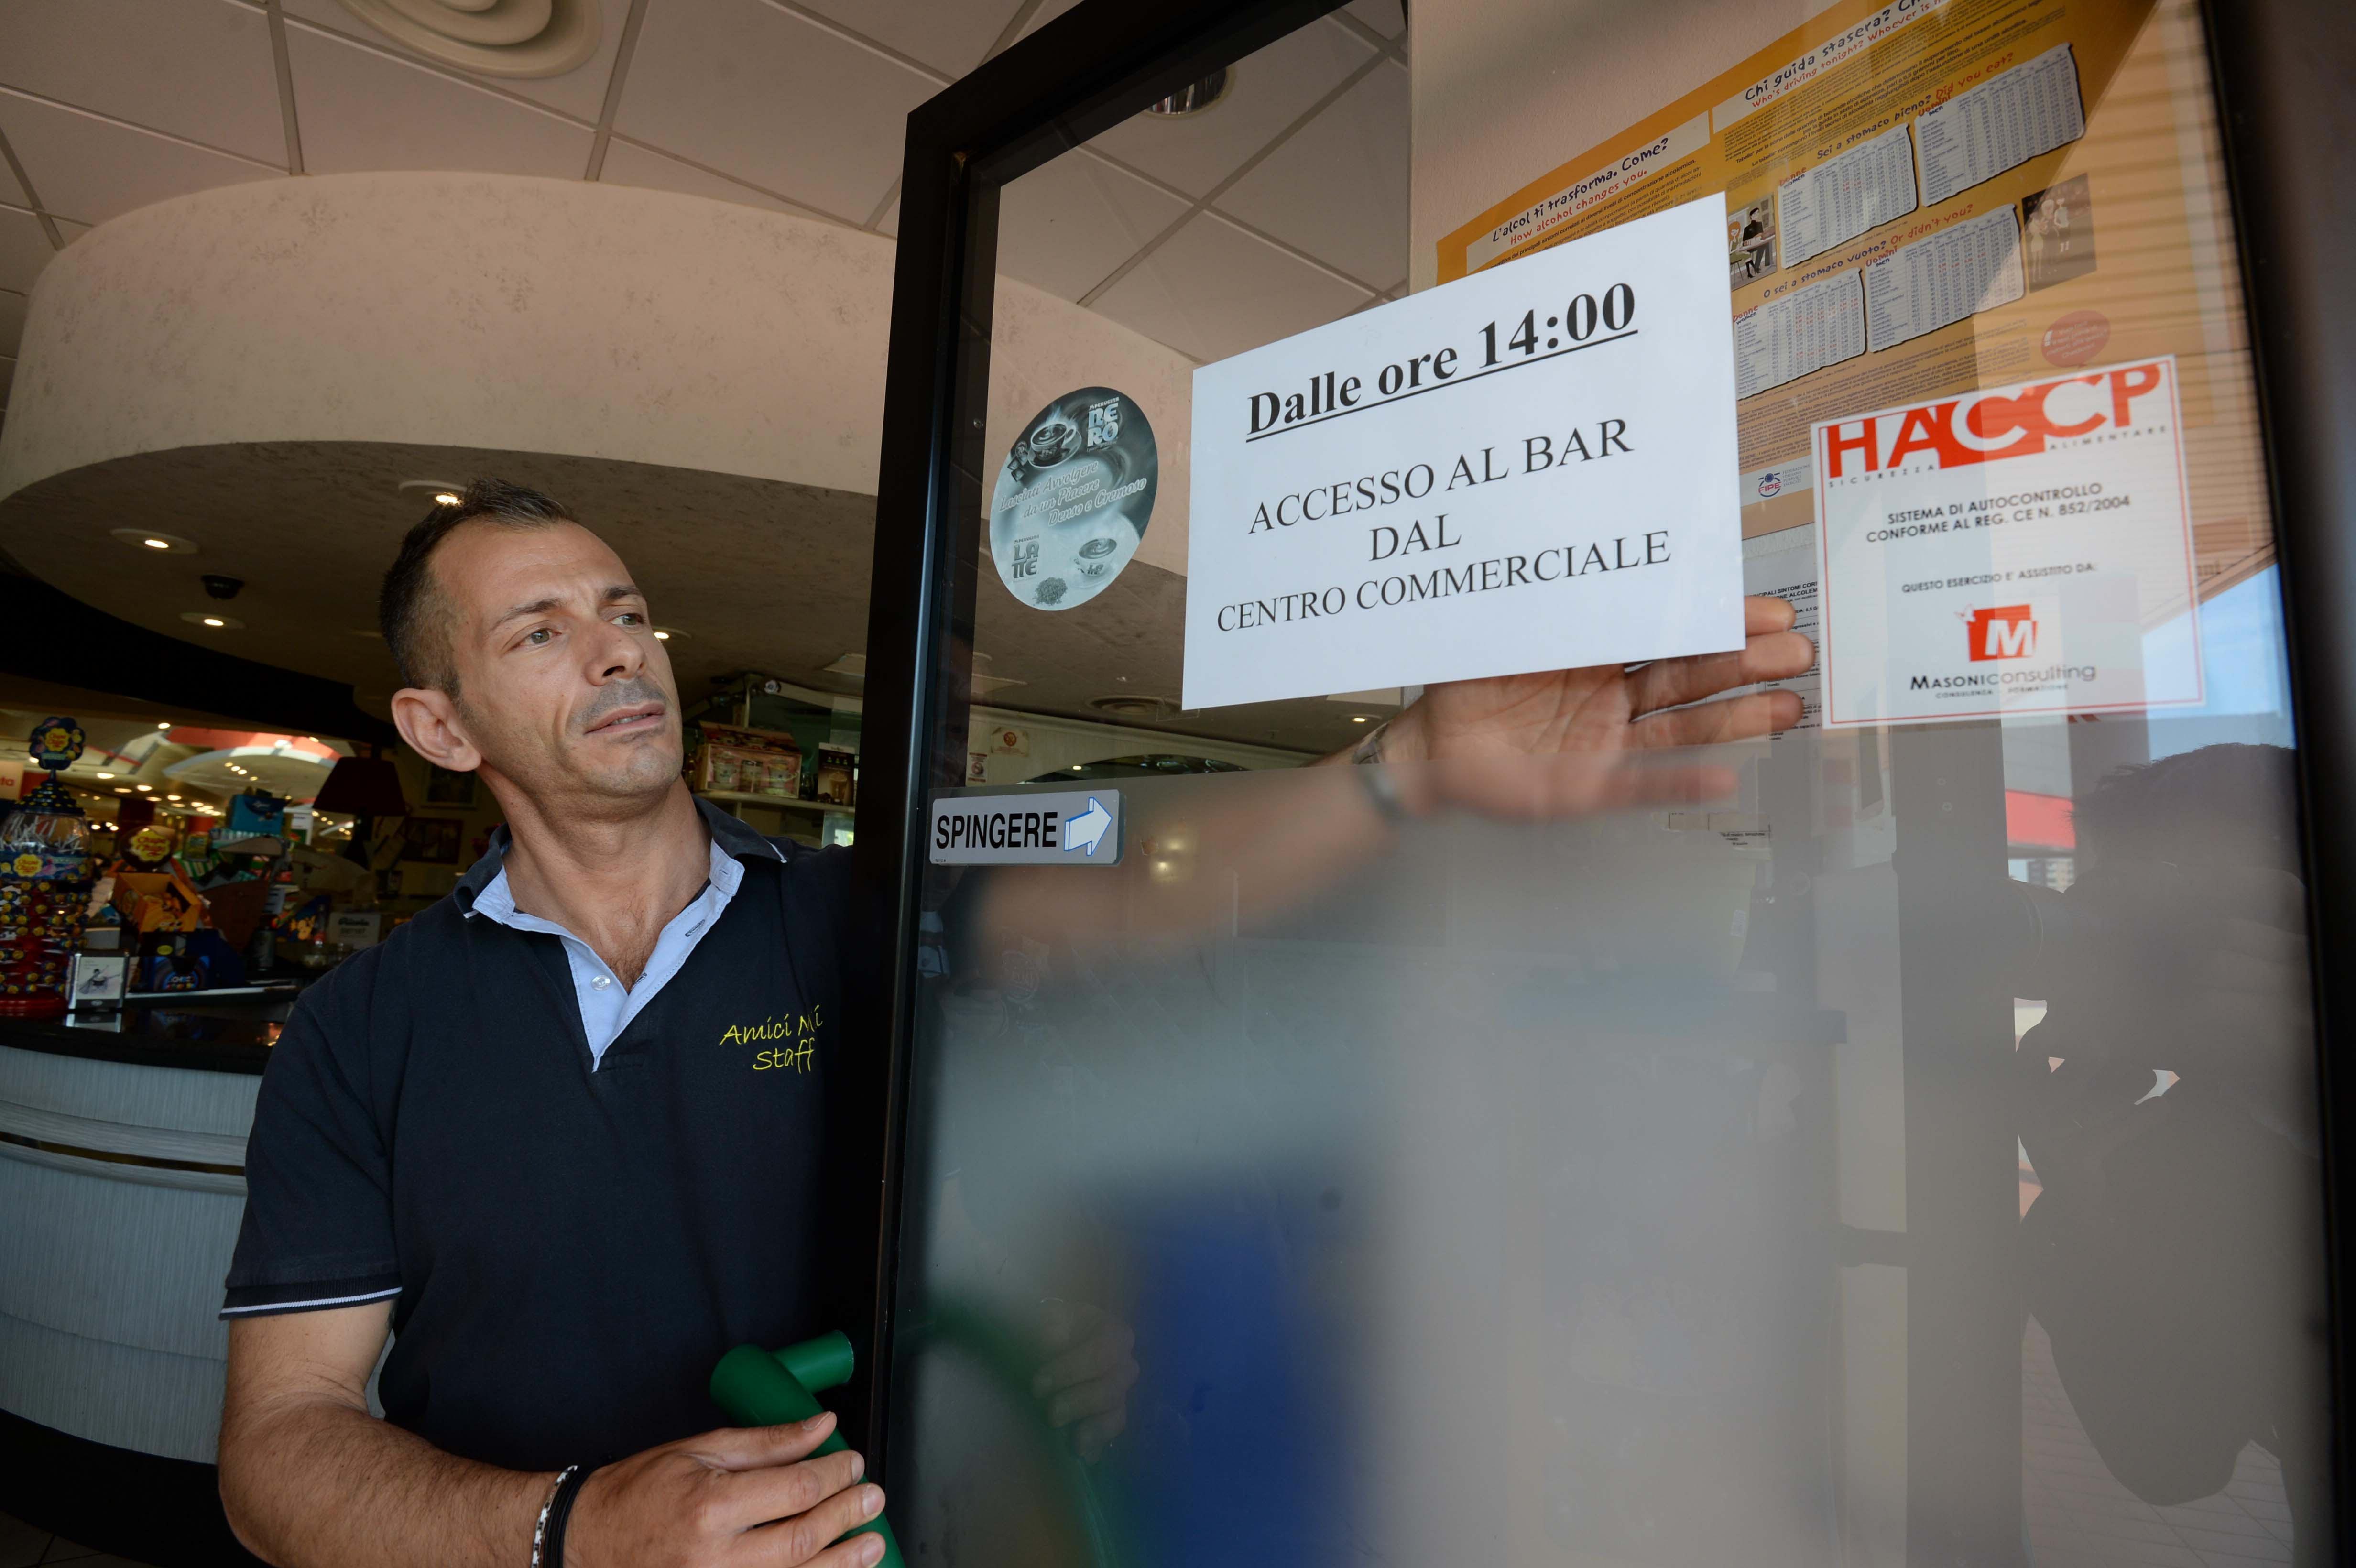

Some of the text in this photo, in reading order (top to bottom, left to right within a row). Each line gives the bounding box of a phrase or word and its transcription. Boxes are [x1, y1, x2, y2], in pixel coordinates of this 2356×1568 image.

[1745, 9, 1890, 100] Chi guida stasera?
[1752, 88, 1781, 109] Who's
[1784, 68, 1817, 90] driving
[1821, 40, 1864, 68] tonight?
[1867, 10, 1917, 43] Whoever
[1921, 4, 1930, 13] is
[1914, 59, 1934, 75] grammi
[1936, 54, 1945, 63] per
[1778, 135, 1807, 153] contengono
[1910, 72, 1924, 83] dopo
[1817, 52, 2014, 159] Sei a stomaco pieno? Did you eat?
[1823, 102, 1845, 117] bevande
[1847, 89, 1870, 105] alcoliche
[1883, 63, 1917, 85] determinano
[1918, 94, 1951, 117] Uomini
[1929, 106, 1943, 116] men
[1493, 138, 1669, 242] L'alcol ti trasforma. Come?
[1779, 166, 1807, 186] Donne
[1510, 170, 1647, 245] How alcohol changes you.
[1519, 240, 1540, 256] principali
[1542, 230, 1559, 243] sintomi
[1560, 219, 1580, 234] correlati
[1624, 175, 1664, 200] concentrazione
[1665, 159, 1696, 178] alcolemica.
[1763, 289, 1771, 298] O
[1774, 283, 1788, 295] sei
[1801, 261, 1843, 283] stomaco
[1847, 240, 1887, 263] vuoto?
[1890, 234, 1904, 245] Or
[1908, 218, 1940, 238] didn't
[1943, 204, 1974, 223] you?
[1866, 246, 1898, 267] Uomini
[1876, 258, 1890, 268] men
[1733, 305, 1758, 322] Donne
[1247, 282, 1636, 436] Dalle ore 14:00
[1827, 363, 2160, 479] HACCP
[999, 461, 1099, 512] Lasciati Avvolgere
[1024, 479, 1100, 519] da un Piacere
[1248, 417, 1635, 535] ACCESSO AL BAR
[1758, 482, 1782, 493] FIPE
[1048, 478, 1147, 527] Denso e Cremoso
[1866, 495, 2130, 543] CONFORME AL REG. CE N. 852/2004
[1888, 482, 2103, 525] SISTEMA DI AUTOCONTROLLO
[1369, 514, 1462, 562] DAL
[1217, 529, 1672, 633] CENTRO COMMERCIALE
[1778, 584, 1801, 594] SINTOMI
[1901, 579, 1944, 593] QUESTO
[1946, 573, 2001, 588] ESERCIZIO
[2018, 565, 2070, 579] ASSISTITO
[935, 812, 1058, 849] SPINGERE
[720, 1013, 792, 1045] Amici
[752, 1037, 815, 1075] Staff
